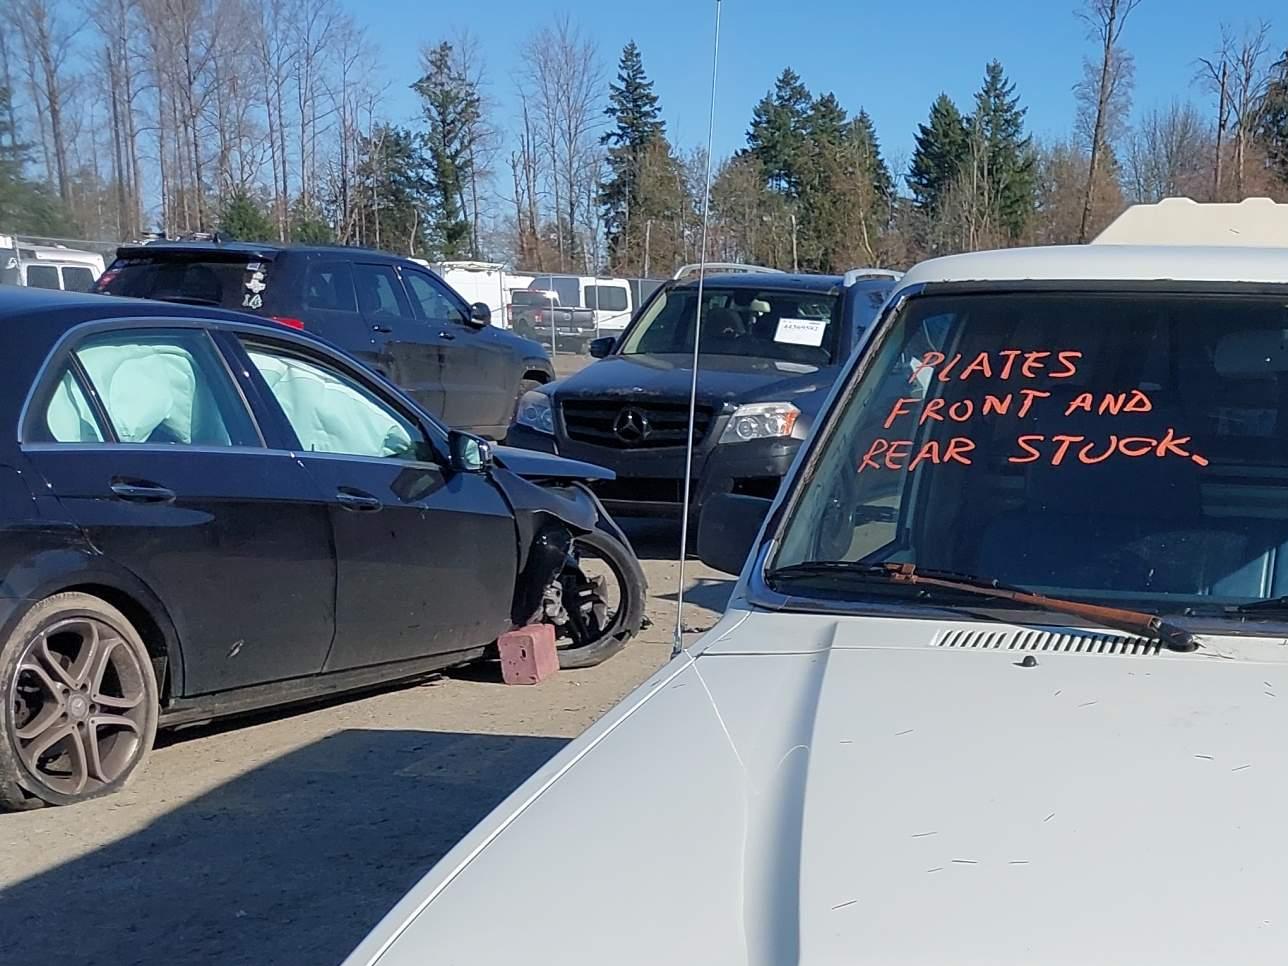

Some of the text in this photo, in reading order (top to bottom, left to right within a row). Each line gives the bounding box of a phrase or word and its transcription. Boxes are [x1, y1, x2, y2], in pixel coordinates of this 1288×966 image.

[908, 350, 1083, 383] PLATES
[883, 389, 1153, 429] FRONT AND
[857, 437, 976, 474] REAR
